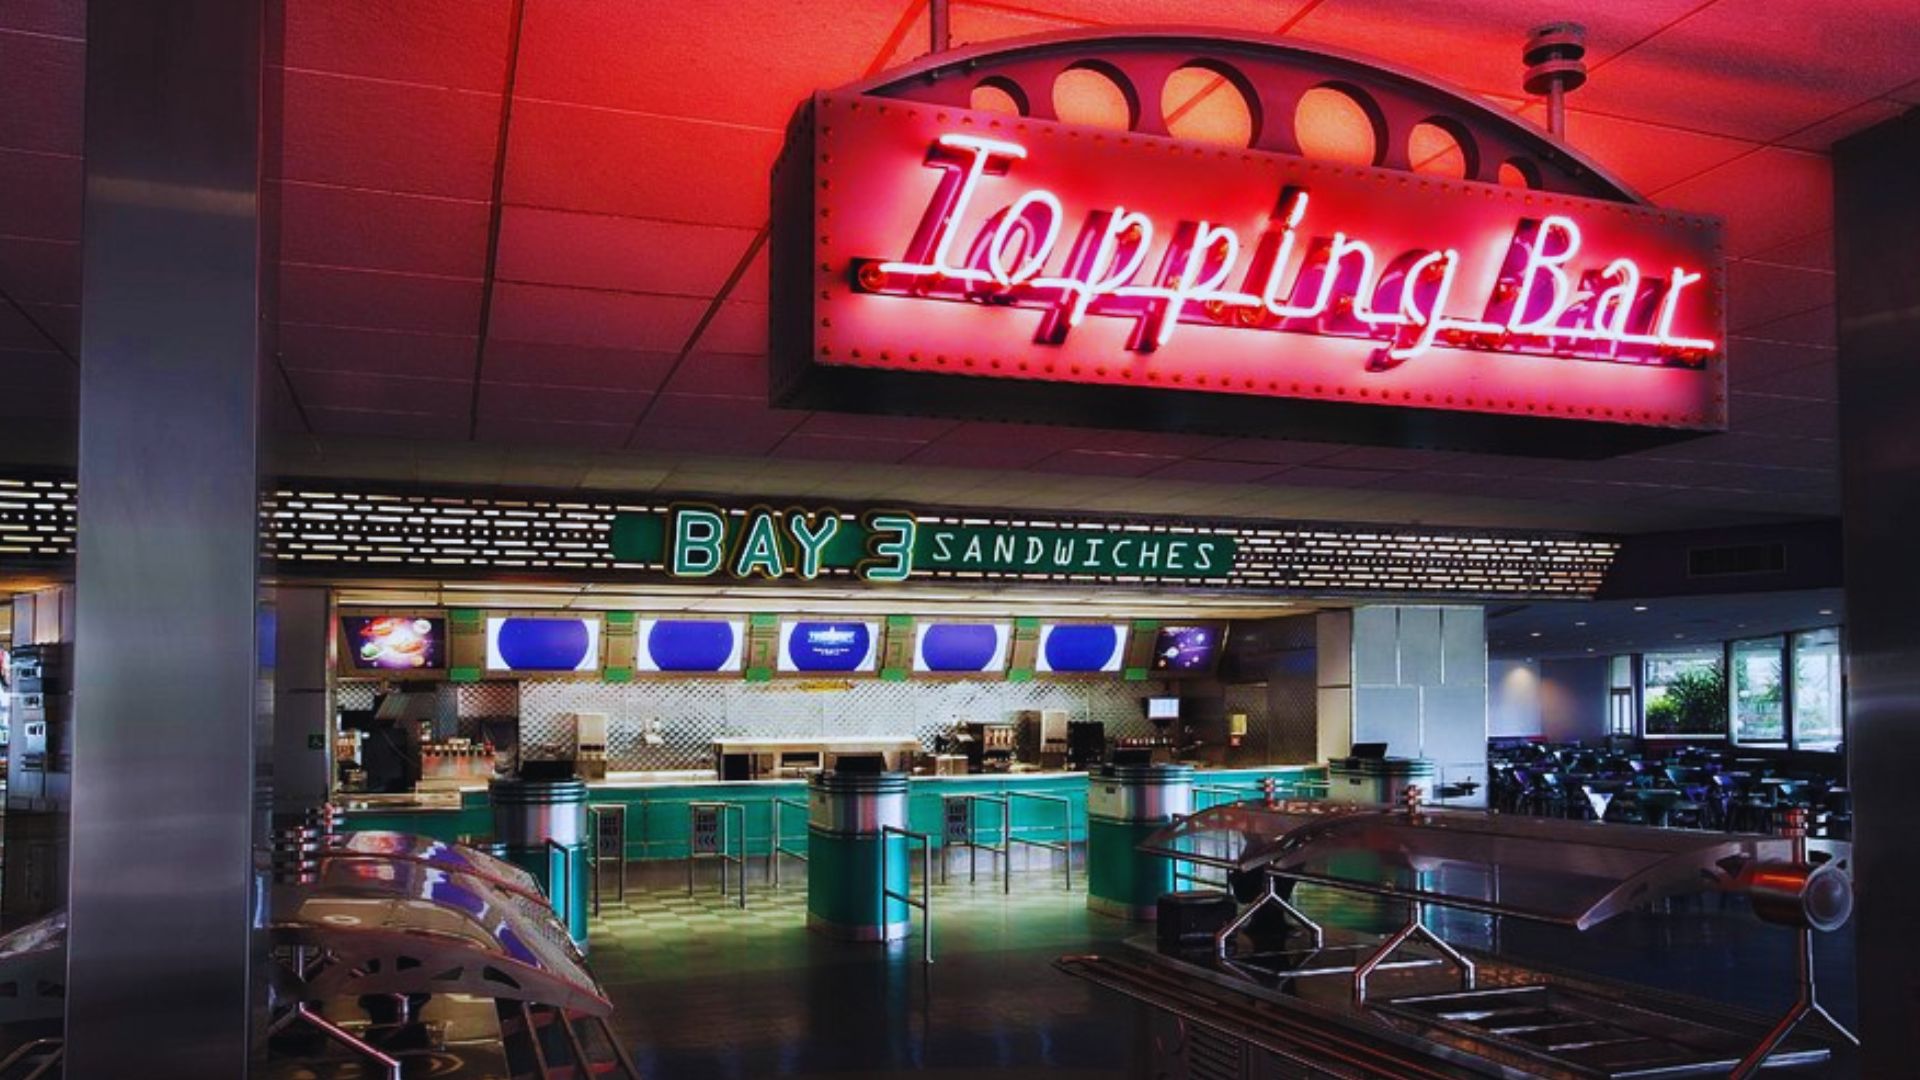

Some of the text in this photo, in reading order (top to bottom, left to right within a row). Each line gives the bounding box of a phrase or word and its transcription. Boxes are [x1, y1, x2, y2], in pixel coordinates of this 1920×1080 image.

[880, 134, 1717, 361] Topping Bar
[674, 510, 1215, 581] BAY 3 SANDWICHES
